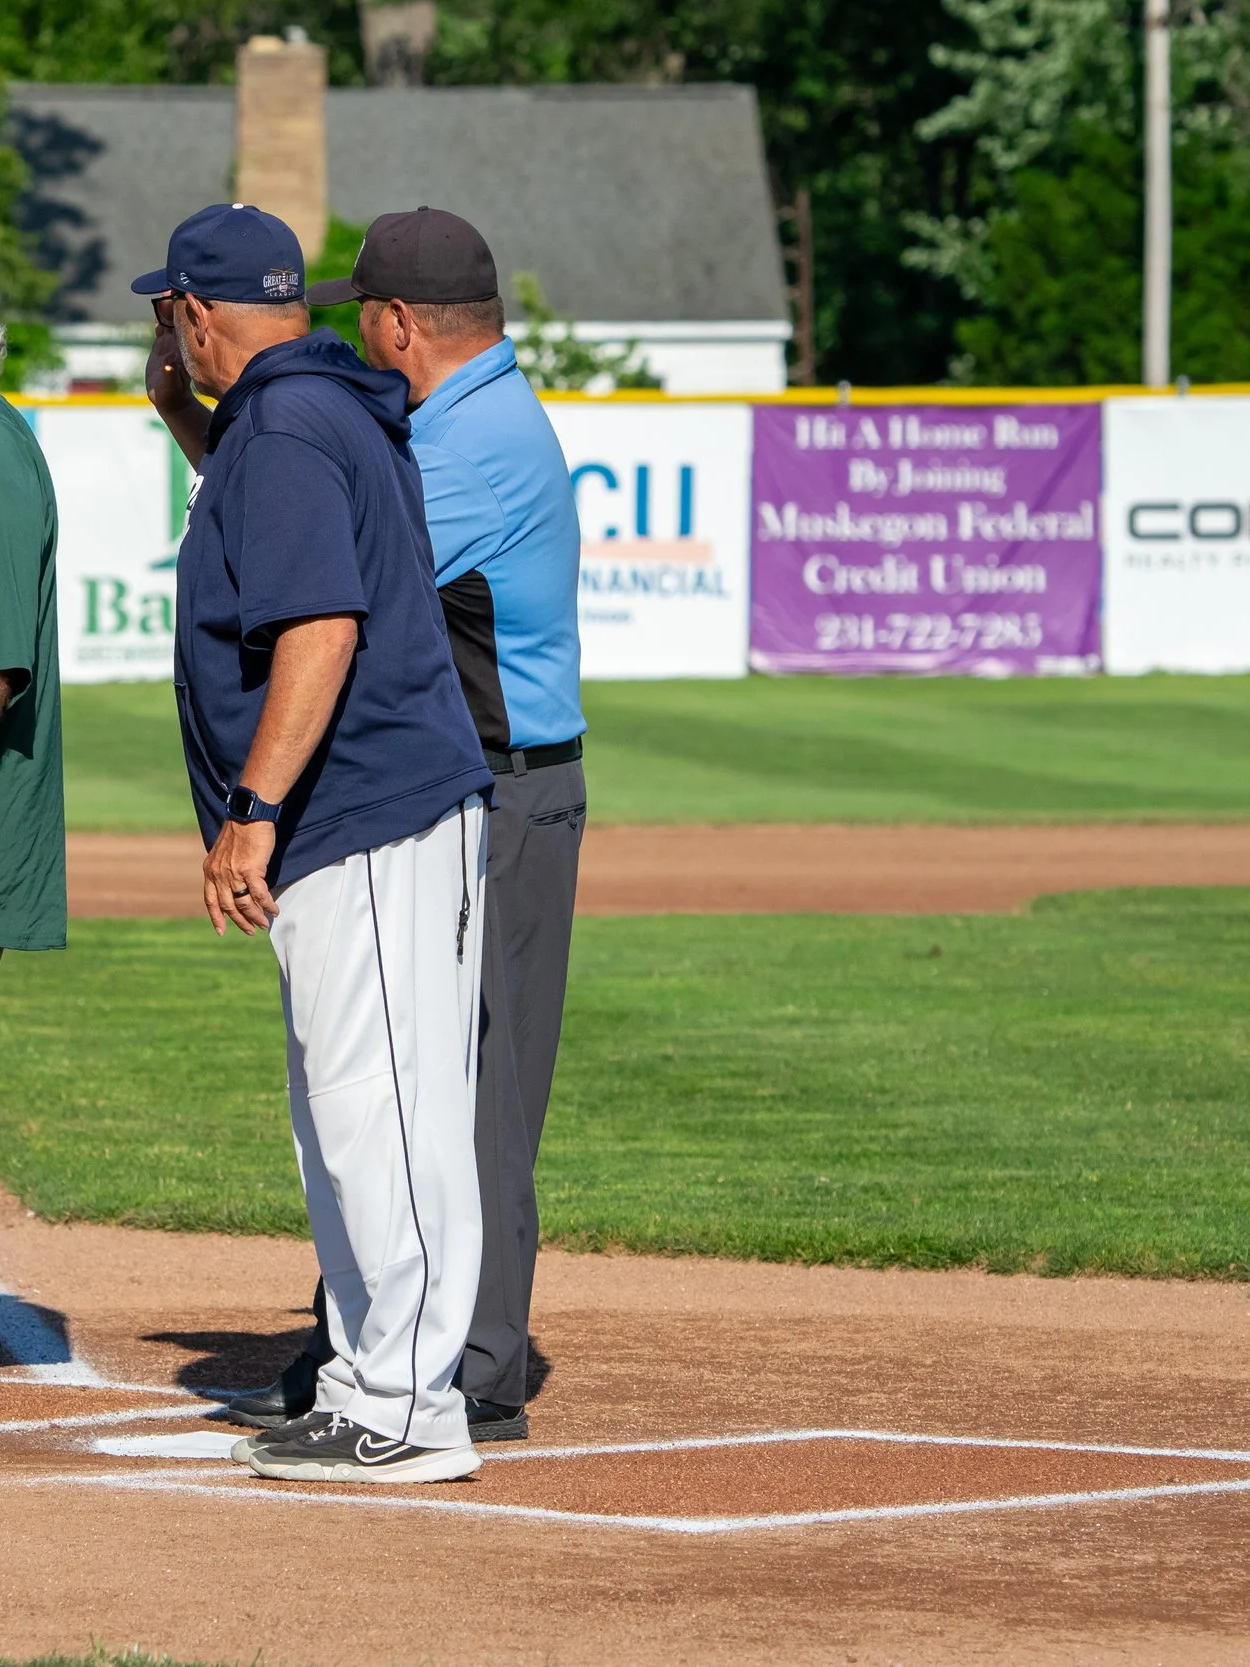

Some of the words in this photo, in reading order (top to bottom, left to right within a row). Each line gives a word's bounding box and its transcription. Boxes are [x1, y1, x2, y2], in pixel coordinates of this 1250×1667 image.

[263, 275, 282, 288] GREAT
[795, 414, 846, 450] Hit
[851, 415, 881, 450] A
[888, 414, 988, 450] Home
[993, 414, 1059, 450] Run
[848, 457, 894, 498] By
[890, 457, 1007, 498] Joining
[757, 500, 948, 549] Muskegon
[957, 500, 1094, 541] Federal
[803, 553, 919, 595] Credit
[928, 553, 1047, 594] Union
